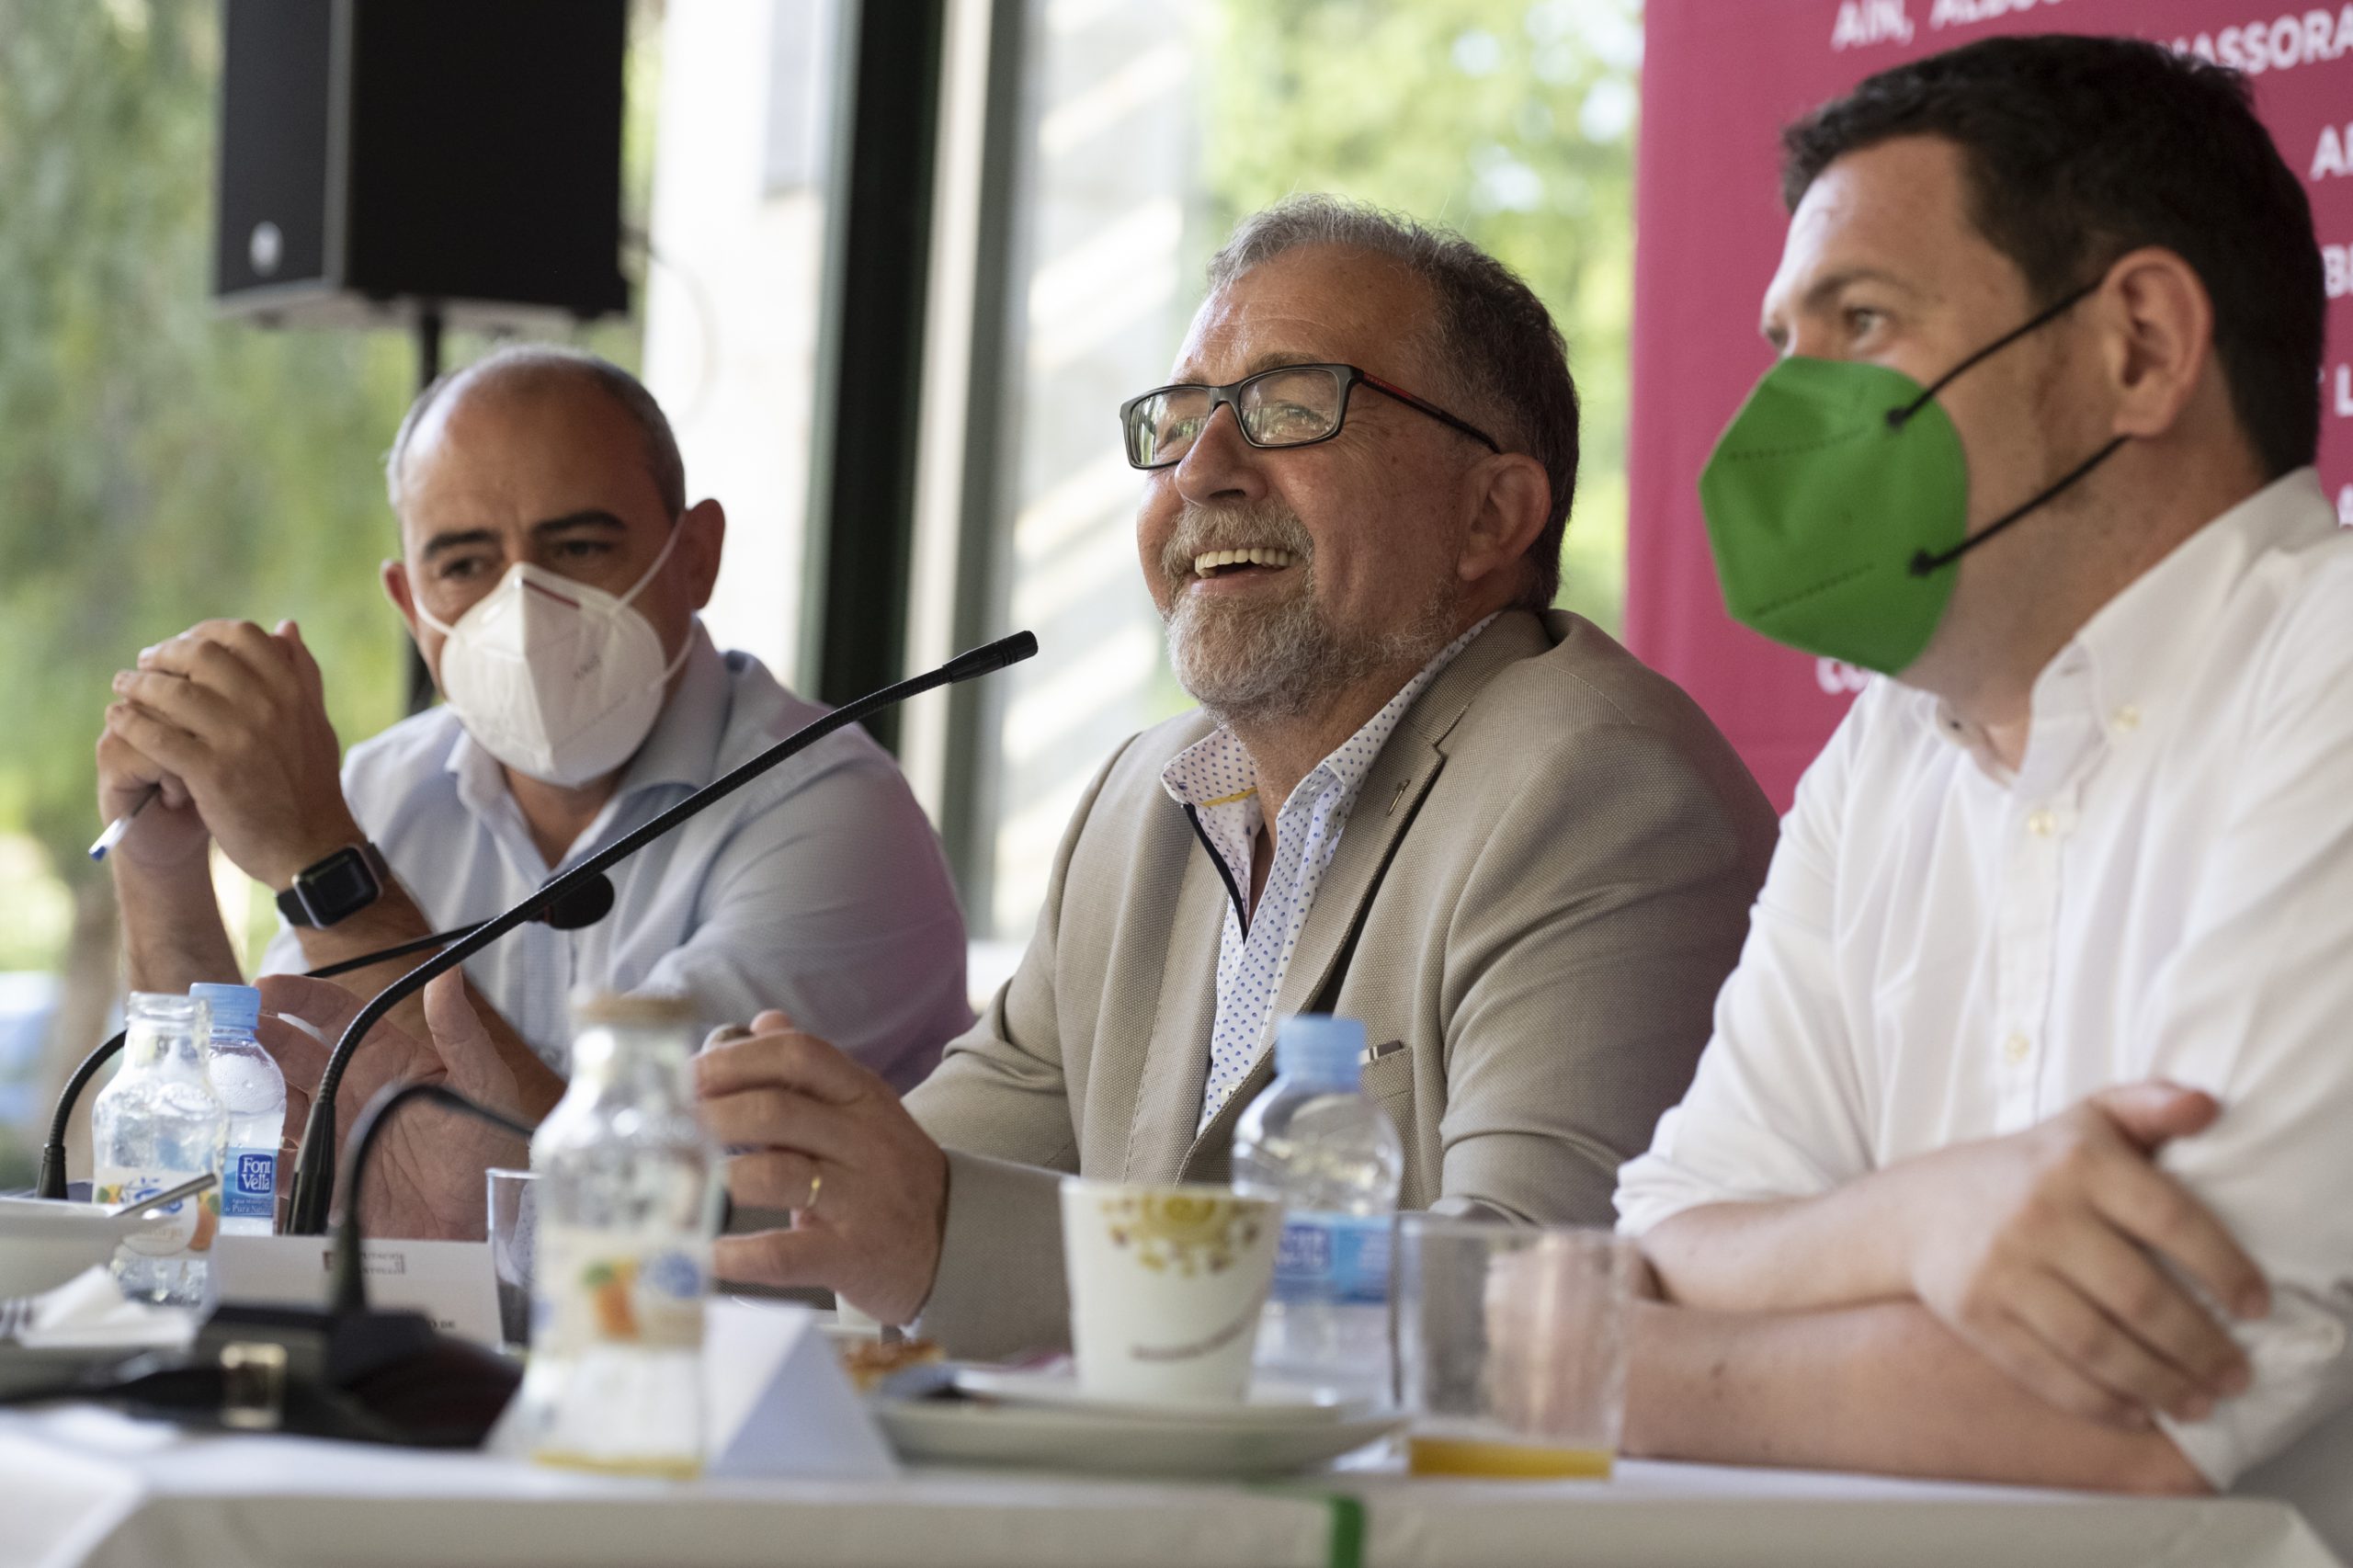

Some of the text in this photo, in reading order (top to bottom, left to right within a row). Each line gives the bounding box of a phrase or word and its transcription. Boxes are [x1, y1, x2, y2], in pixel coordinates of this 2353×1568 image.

[2154, 3, 2353, 75] ASSORA
[2308, 124, 2353, 182] A
[241, 1174, 270, 1190] Vella
[243, 1157, 271, 1174] Font
